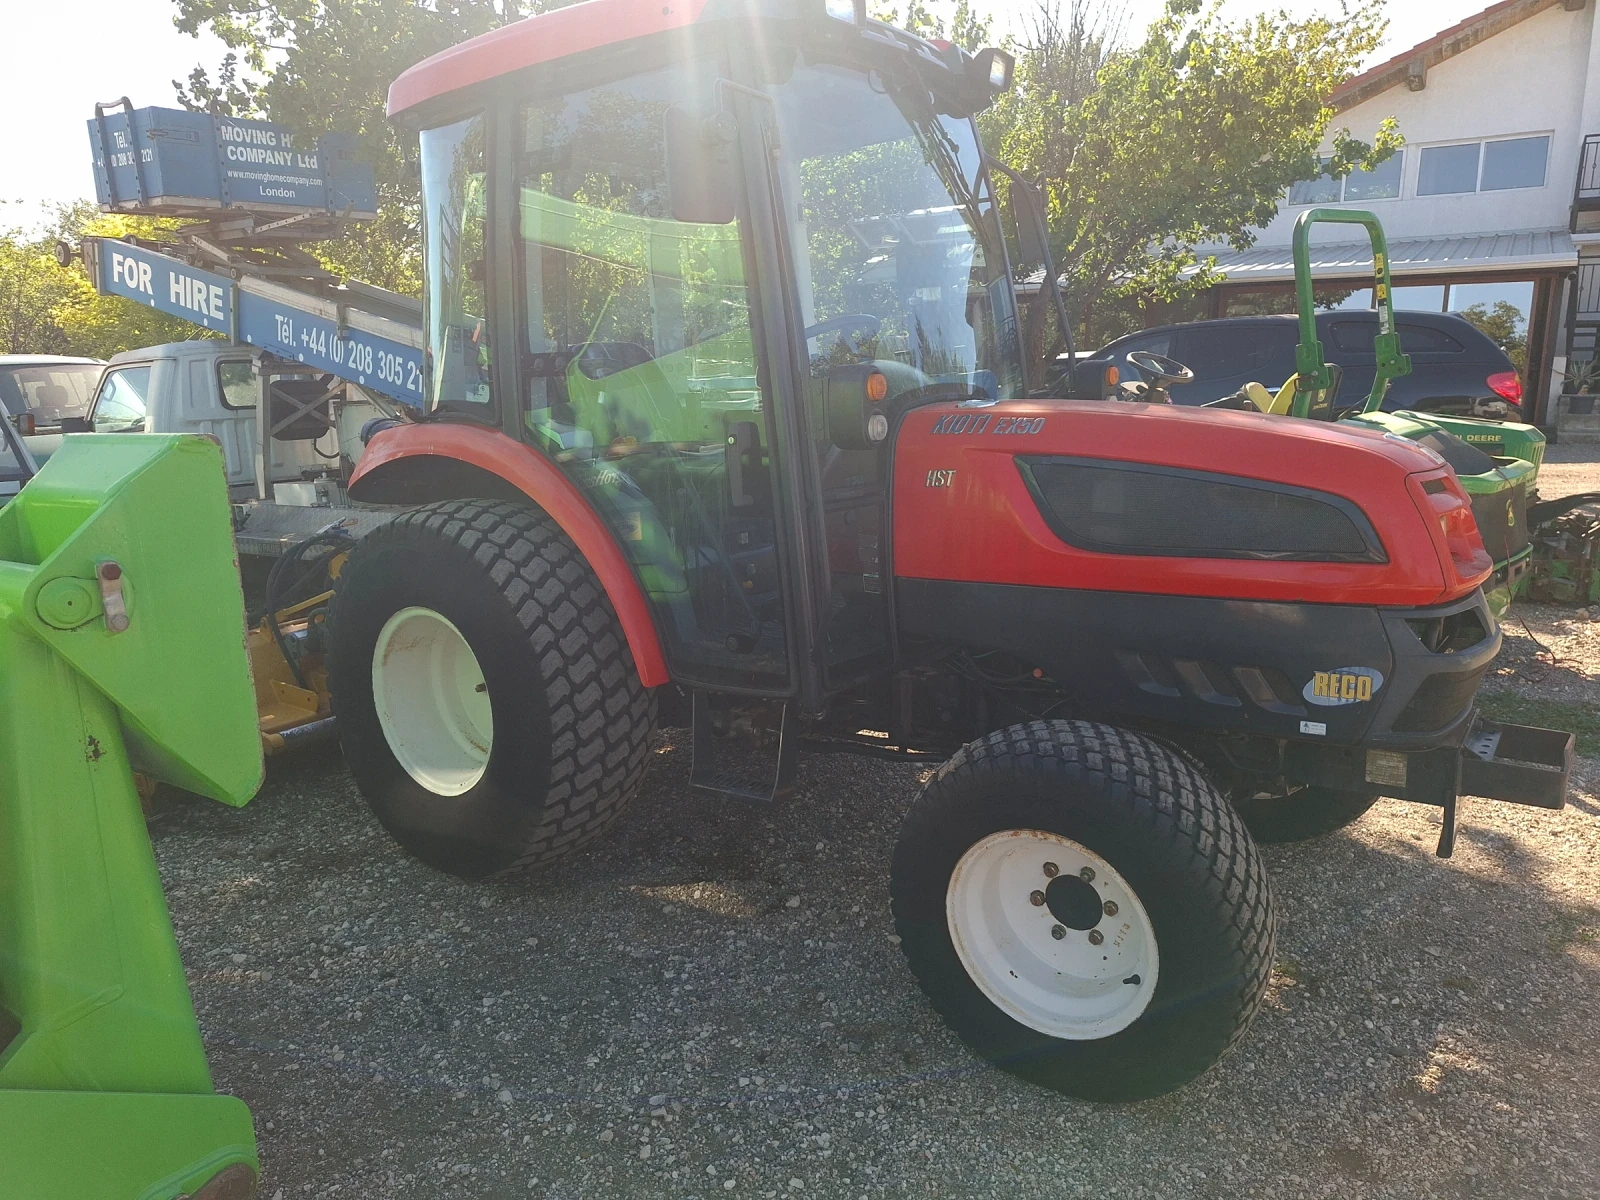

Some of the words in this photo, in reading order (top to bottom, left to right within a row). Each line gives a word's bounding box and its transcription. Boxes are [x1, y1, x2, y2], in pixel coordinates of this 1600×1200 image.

[113, 131, 128, 148] Tél.
[221, 125, 277, 146] MOVING
[227, 145, 292, 166] COMPANY
[298, 153, 318, 169] Ltd
[226, 169, 323, 187] www.movinghomecompany.com
[259, 185, 296, 198] London
[112, 252, 154, 295] FOR
[169, 271, 224, 321] HIRE
[275, 314, 296, 347] Tél.
[301, 327, 327, 358] +44
[329, 333, 344, 364] (0)
[348, 340, 373, 375] 208
[377, 350, 403, 386] 305
[930, 413, 993, 435] KIOTI
[991, 416, 1046, 435] EX50
[925, 470, 957, 487] HST
[1312, 671, 1373, 701] RECO
